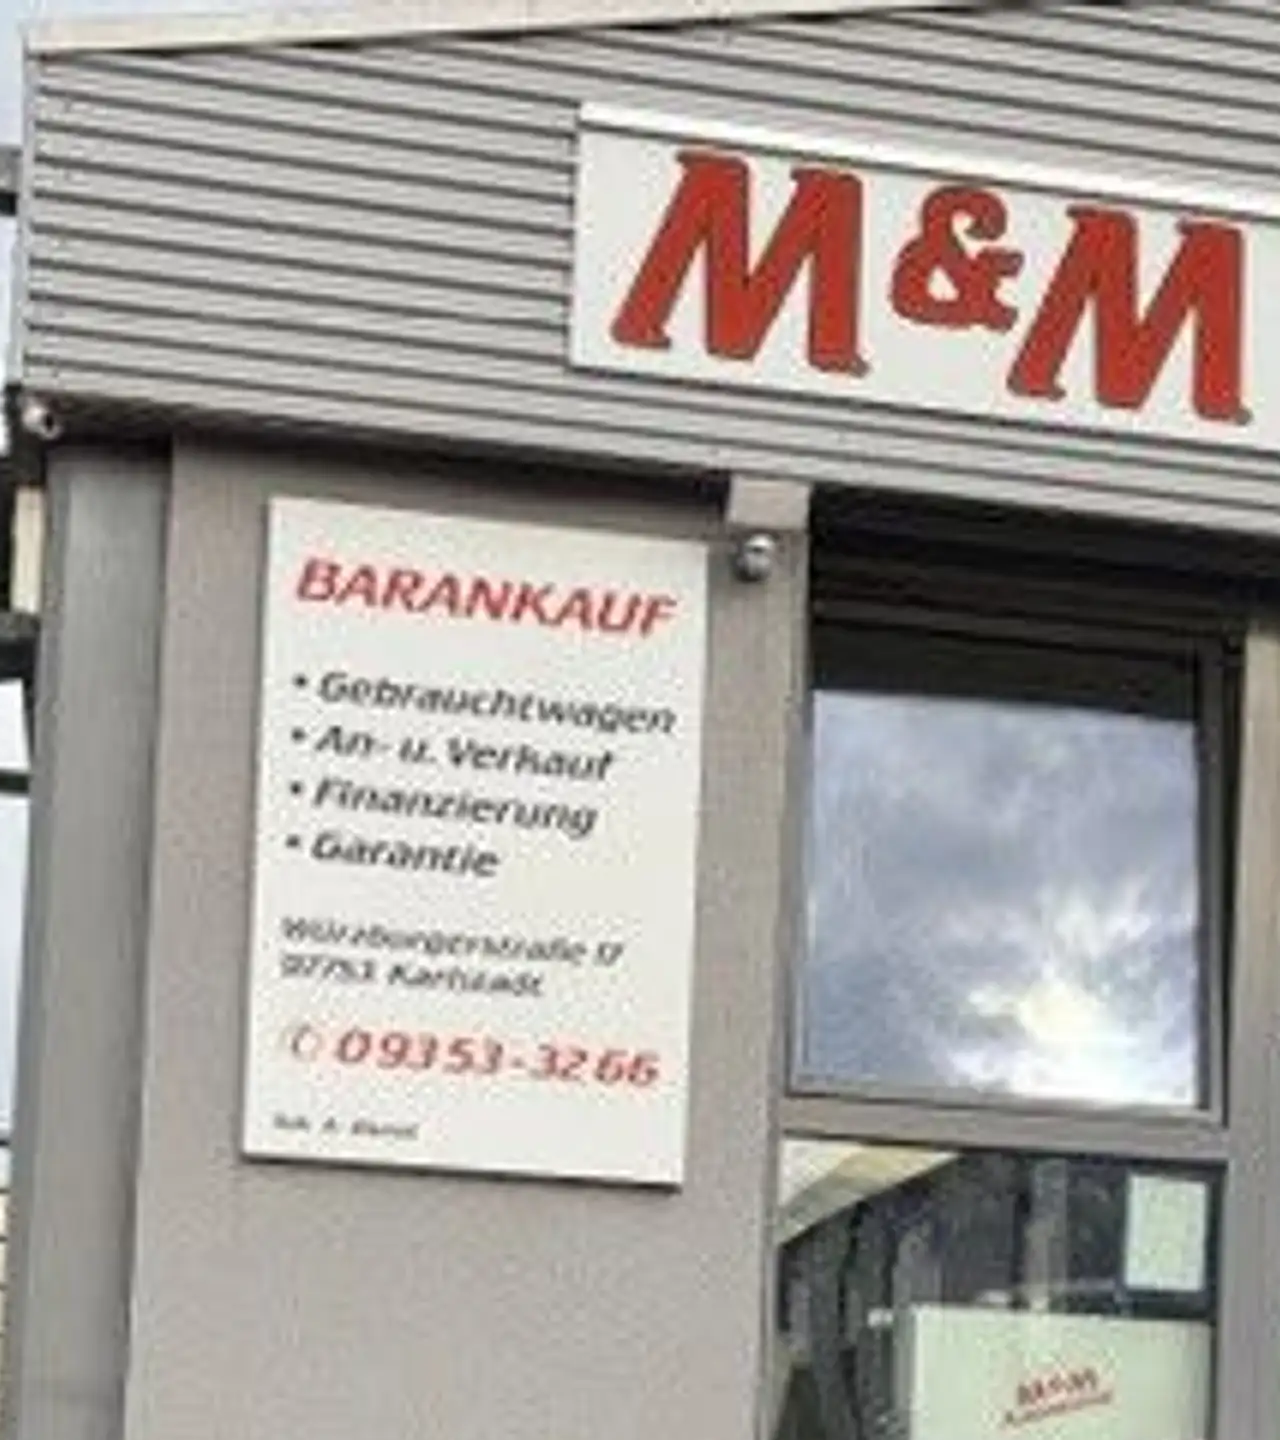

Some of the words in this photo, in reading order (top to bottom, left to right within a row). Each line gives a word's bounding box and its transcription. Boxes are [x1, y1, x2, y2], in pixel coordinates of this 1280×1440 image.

[611, 146, 1253, 426] M&M
[296, 558, 677, 636] BARANKAUF
[319, 672, 676, 735] Gebrauchtwagen
[316, 726, 387, 757] An-
[447, 737, 615, 781] Verkauf
[313, 779, 598, 839] Finanzierung
[310, 833, 500, 877] Garantie
